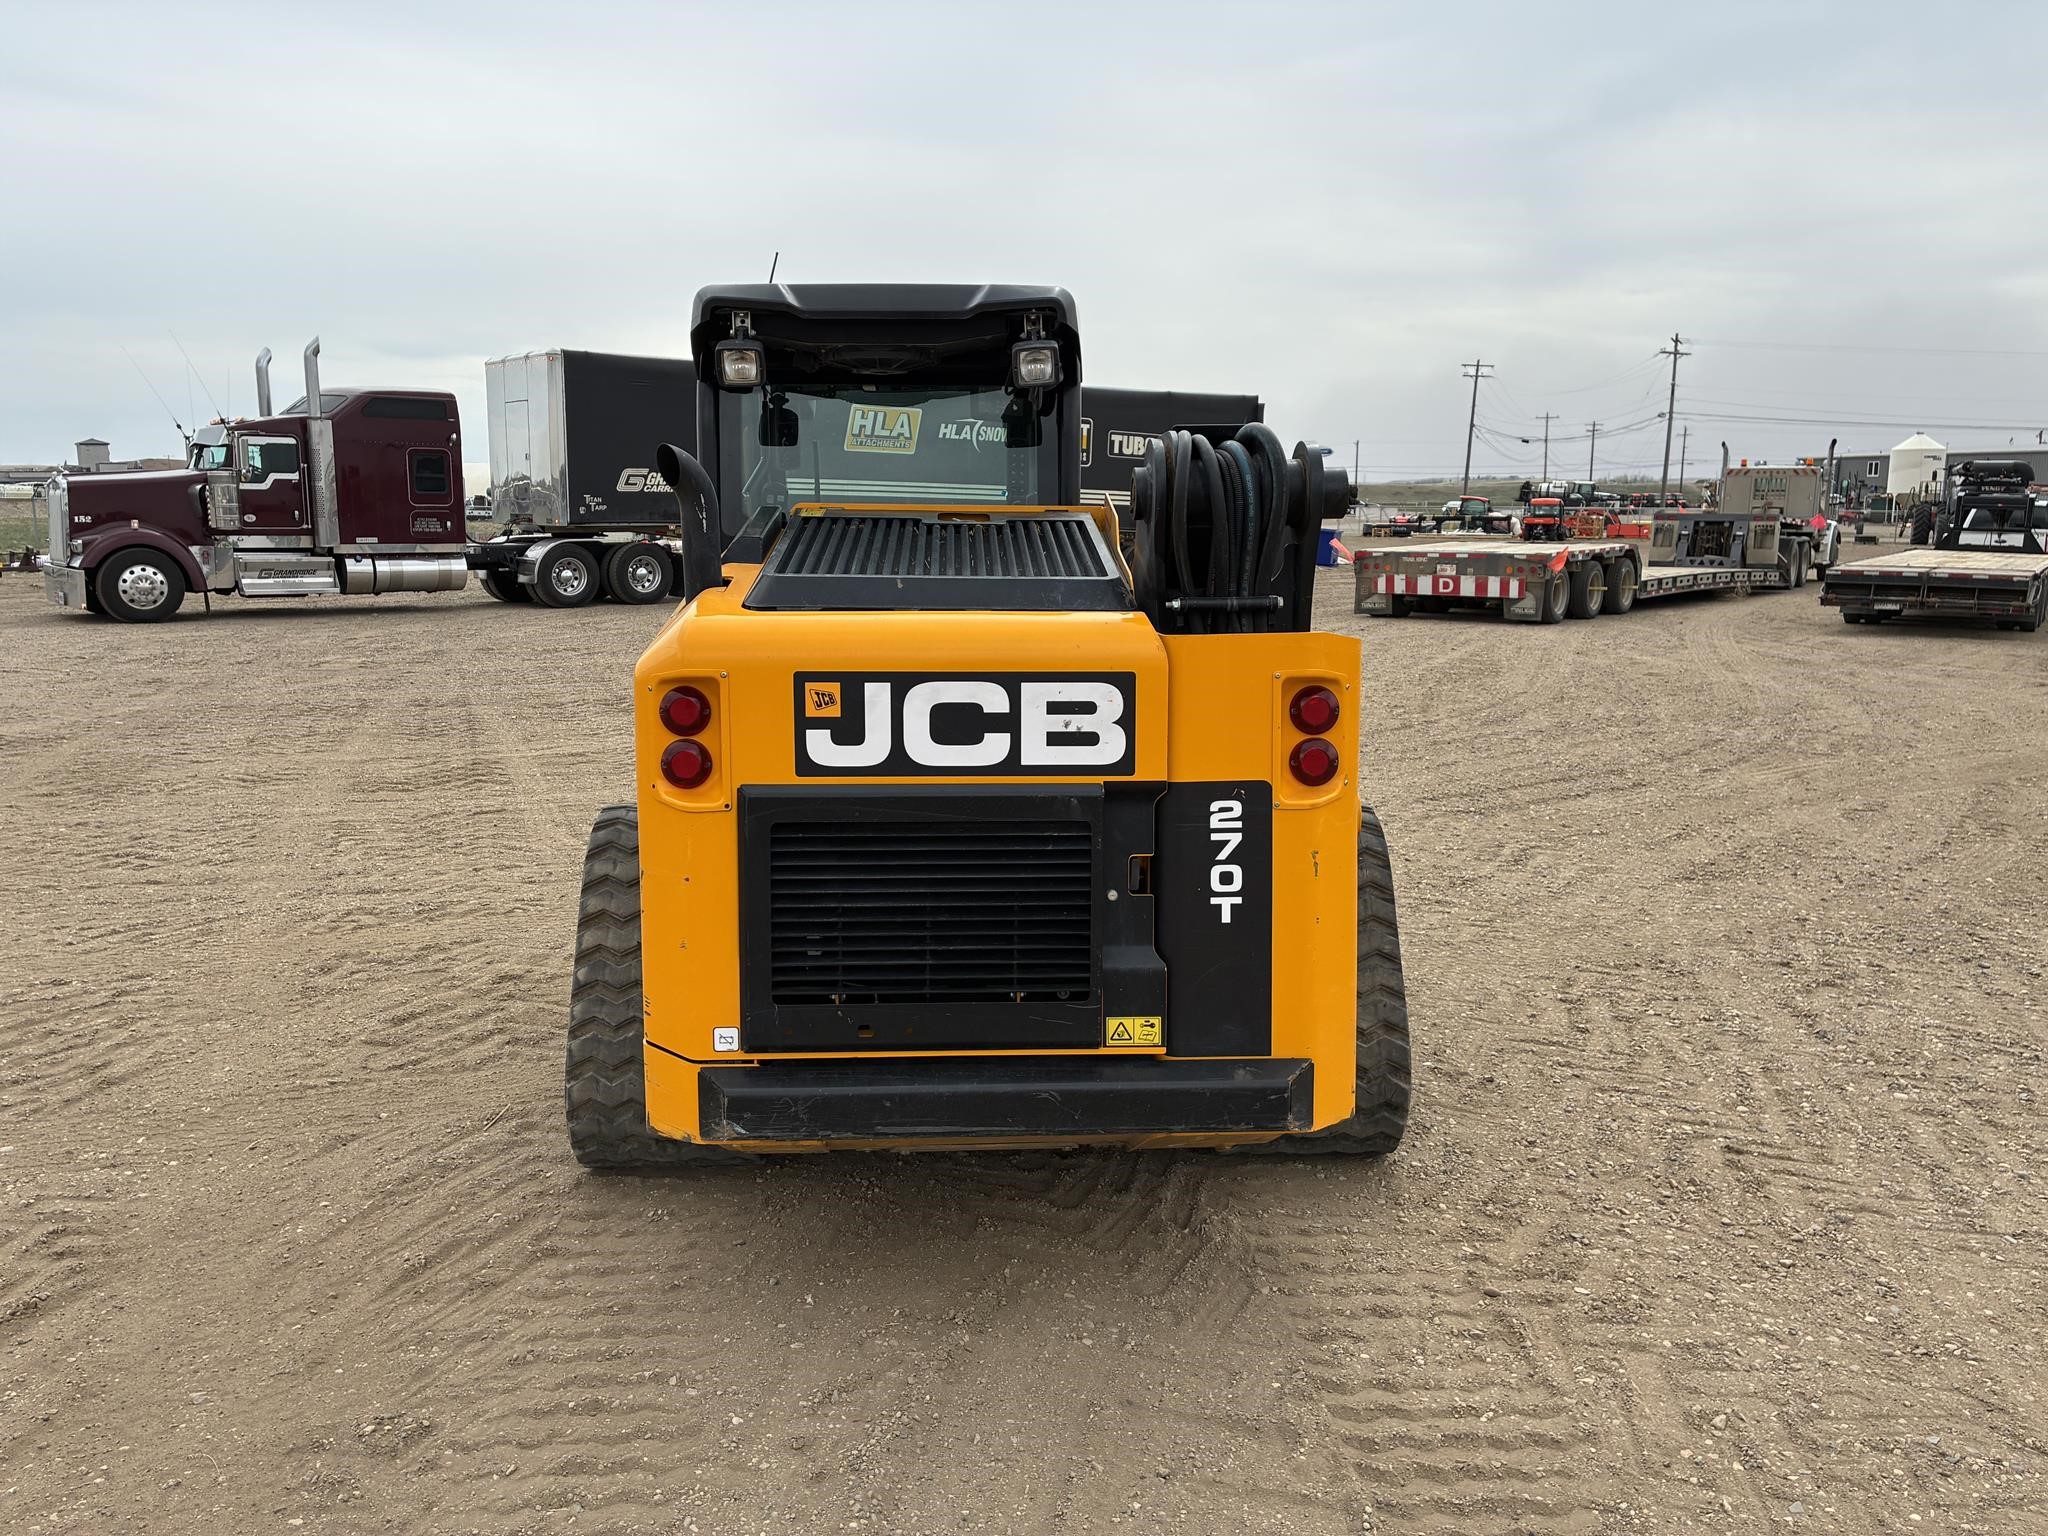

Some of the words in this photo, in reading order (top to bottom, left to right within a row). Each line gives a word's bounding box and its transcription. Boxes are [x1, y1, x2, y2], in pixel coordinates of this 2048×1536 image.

[852, 410, 911, 438] HLA
[938, 423, 972, 440] HLA
[851, 438, 912, 448] ATTACHMENTS
[1110, 434, 1145, 456] TUB
[73, 515, 92, 523] 152
[1438, 578, 1454, 593] D
[814, 691, 836, 709] JCB
[805, 681, 1127, 767] JCB
[1209, 800, 1243, 924] 270T
